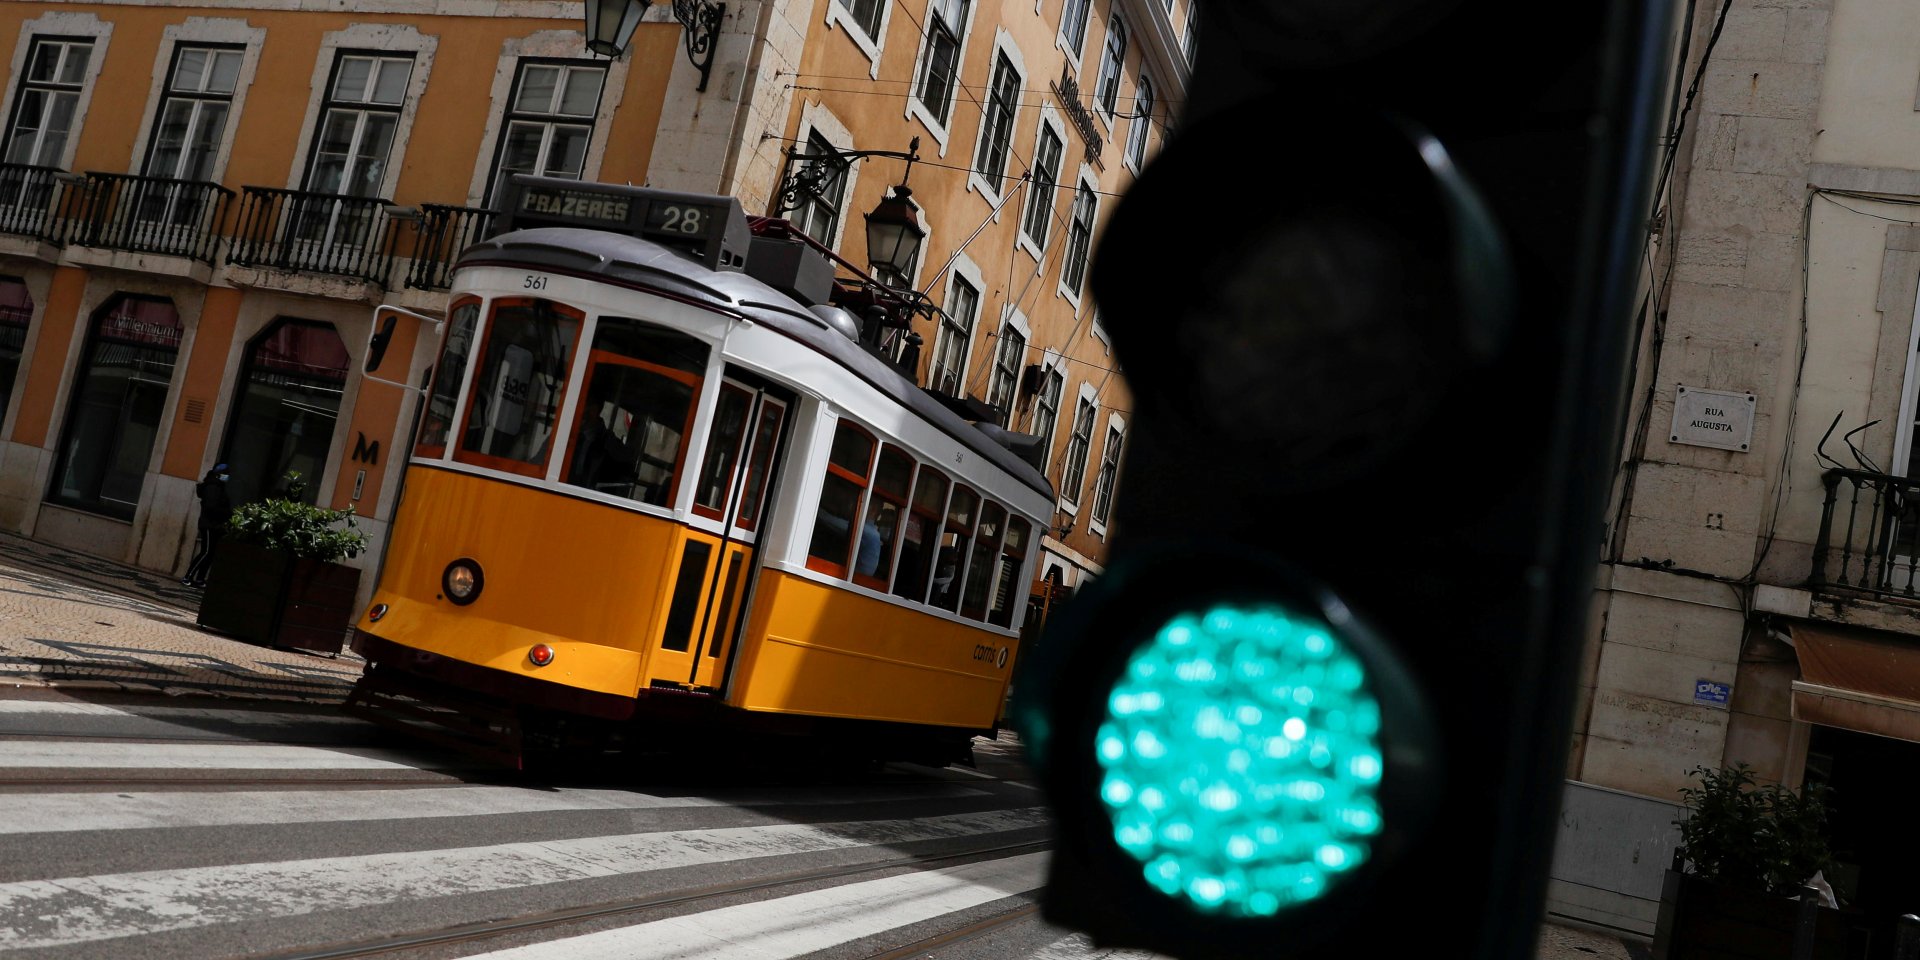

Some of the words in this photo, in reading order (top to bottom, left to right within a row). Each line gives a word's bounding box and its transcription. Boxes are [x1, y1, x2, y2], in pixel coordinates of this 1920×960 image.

[522, 193, 629, 221] PRAZERES
[660, 206, 701, 234] 28
[523, 275, 548, 290] 561
[114, 312, 176, 337] Millennium
[1705, 407, 1724, 417] RUA
[1690, 420, 1733, 432] AUGUSTA
[352, 431, 379, 465] M
[973, 642, 996, 663] carris
